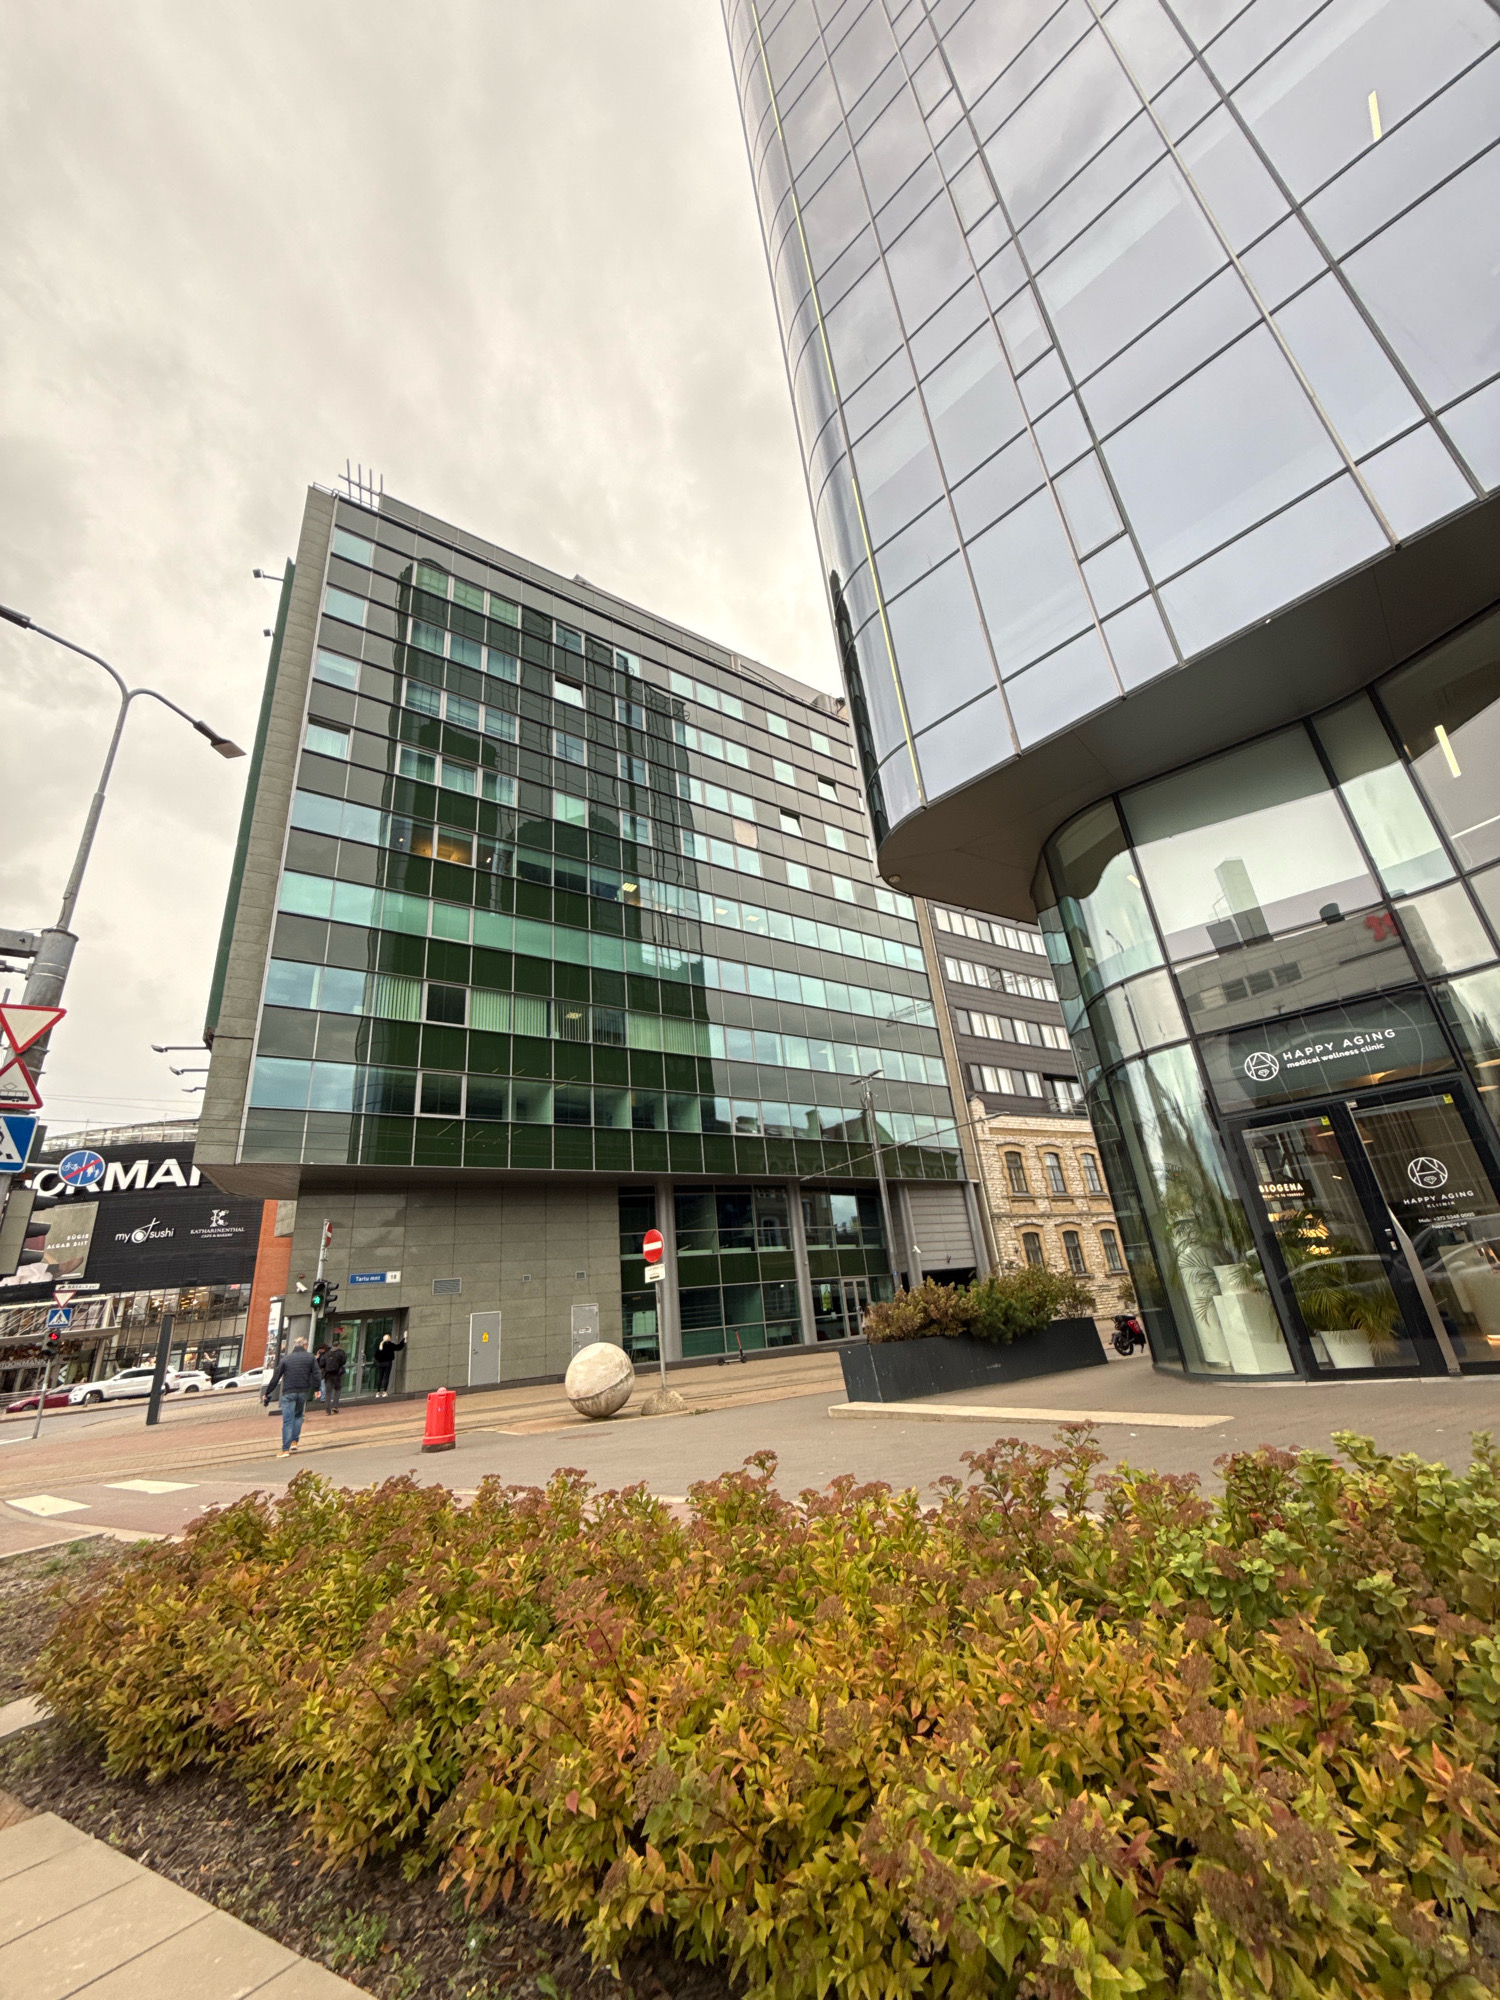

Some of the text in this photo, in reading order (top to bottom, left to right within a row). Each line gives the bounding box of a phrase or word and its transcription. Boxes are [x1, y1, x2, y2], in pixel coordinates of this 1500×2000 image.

[1282, 1028, 1396, 1061] HAPPY AGING
[1286, 1042, 1385, 1069] medical wellness clinic
[1259, 1183, 1304, 1193] BIOGENA
[1403, 1190, 1474, 1205] HAPPY AGING
[115, 1228, 174, 1243] my sushi
